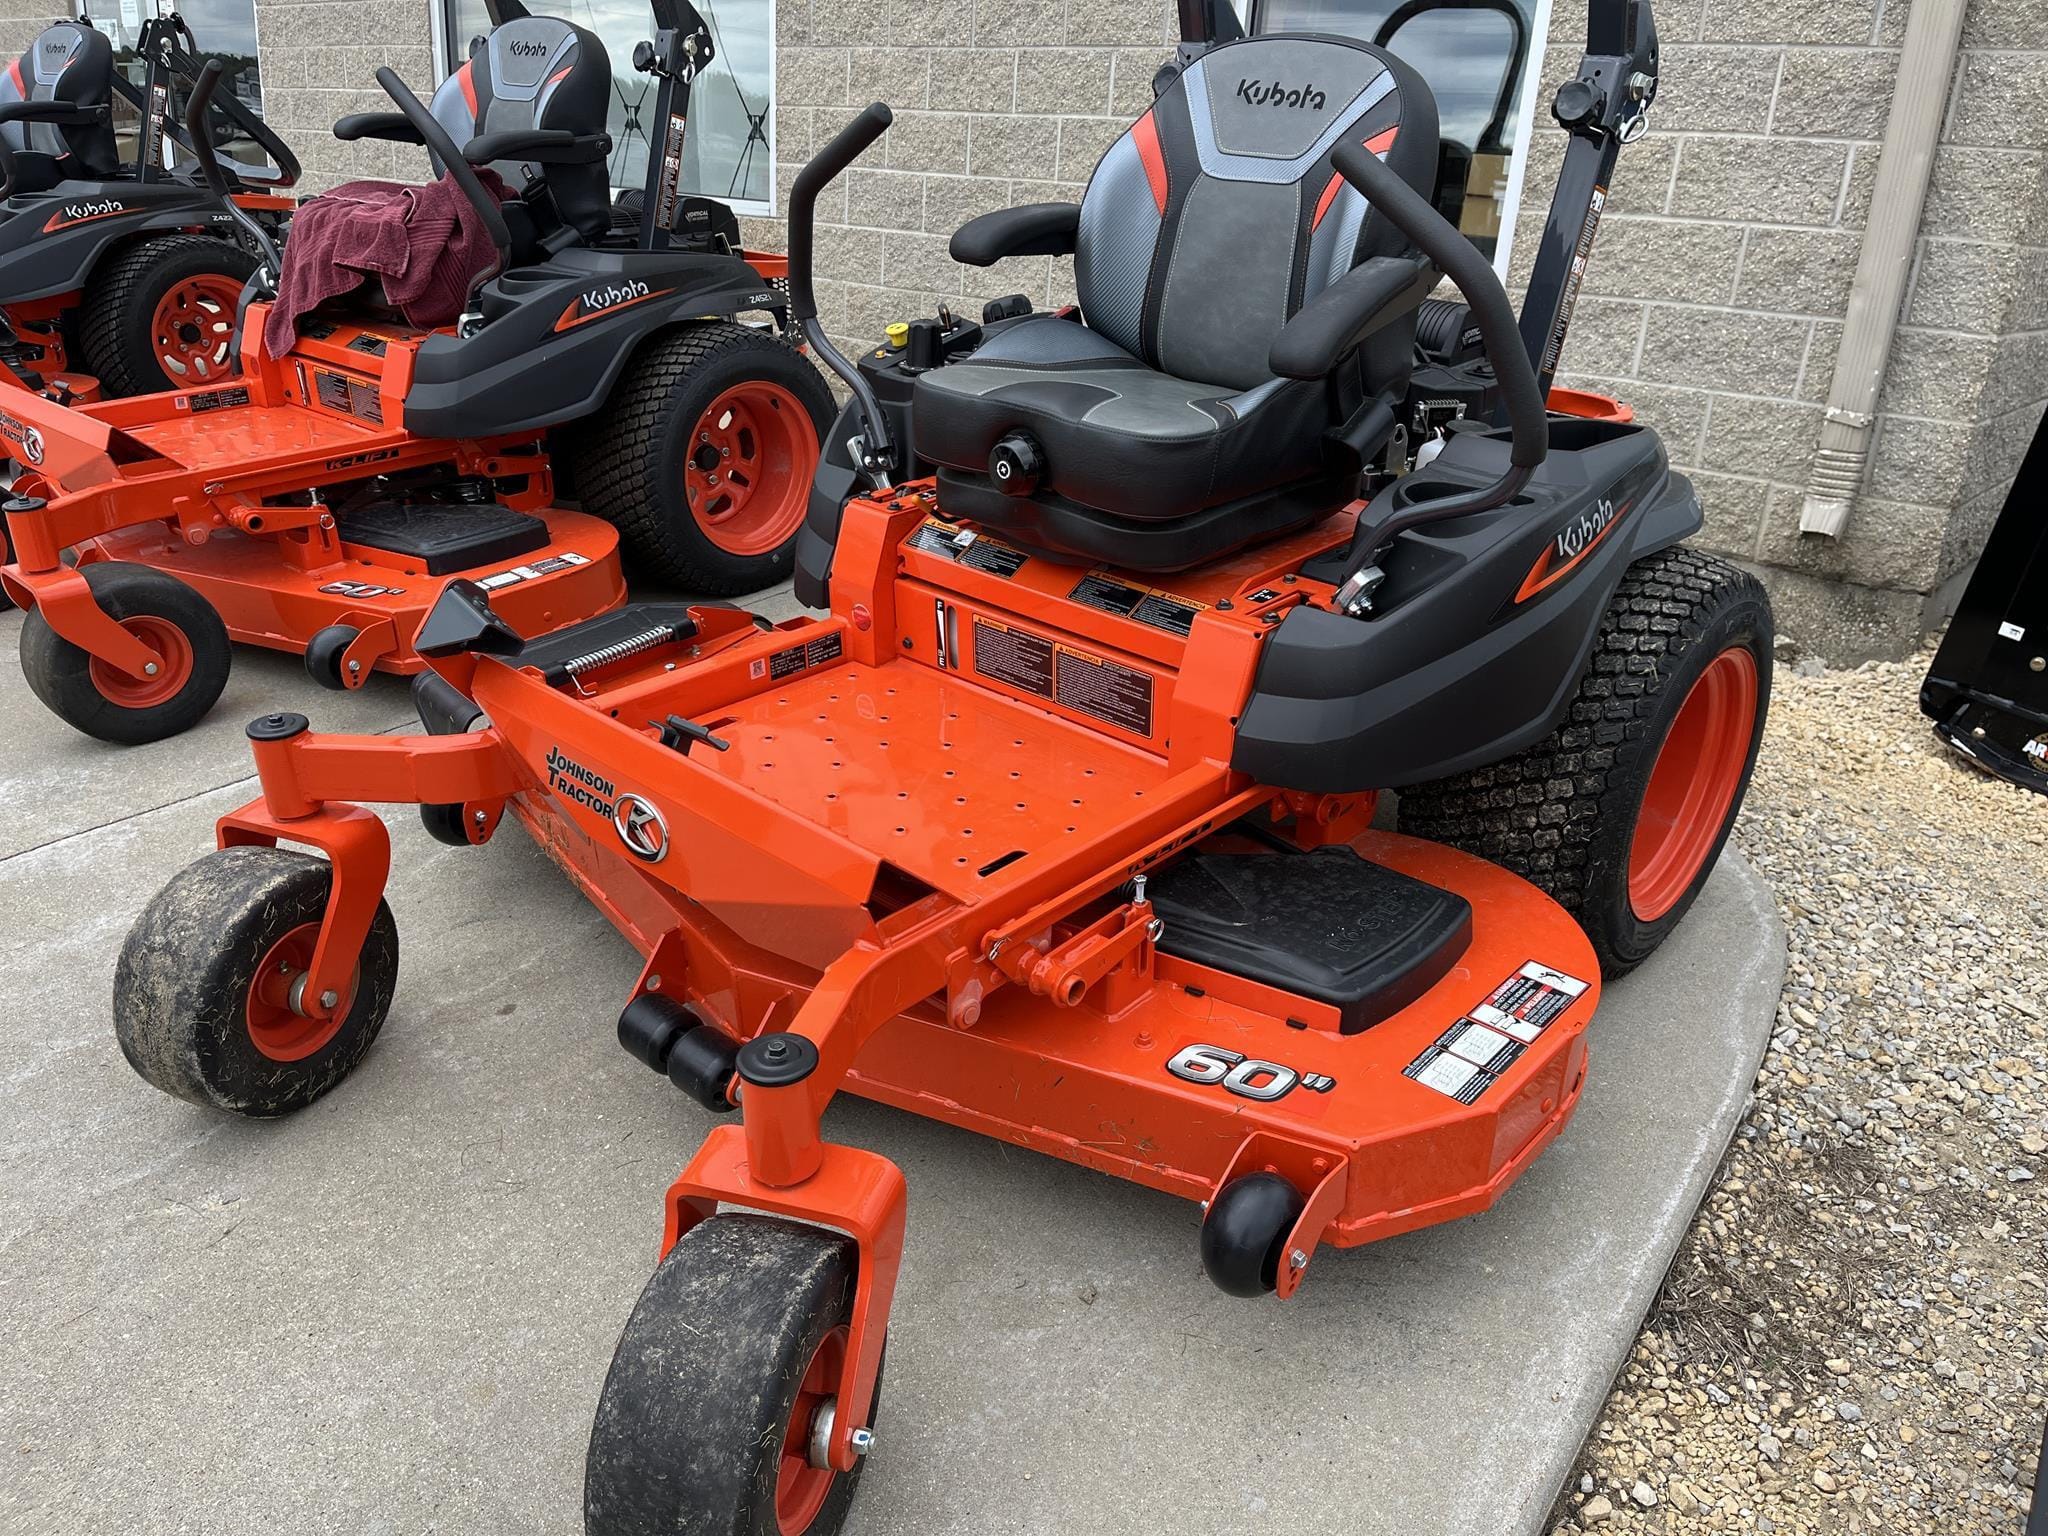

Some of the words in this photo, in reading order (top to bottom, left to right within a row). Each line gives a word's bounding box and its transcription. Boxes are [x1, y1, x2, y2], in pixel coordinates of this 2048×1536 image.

[510, 40, 547, 56] Kubota
[1236, 79, 1326, 110] Kubota
[65, 199, 123, 219] Kubota
[583, 279, 649, 309] Kubota
[1557, 499, 1613, 557] Kubota
[546, 746, 614, 797] JOHNSON
[548, 765, 613, 819] TRACTOR
[1165, 1043, 1337, 1102] 60"
